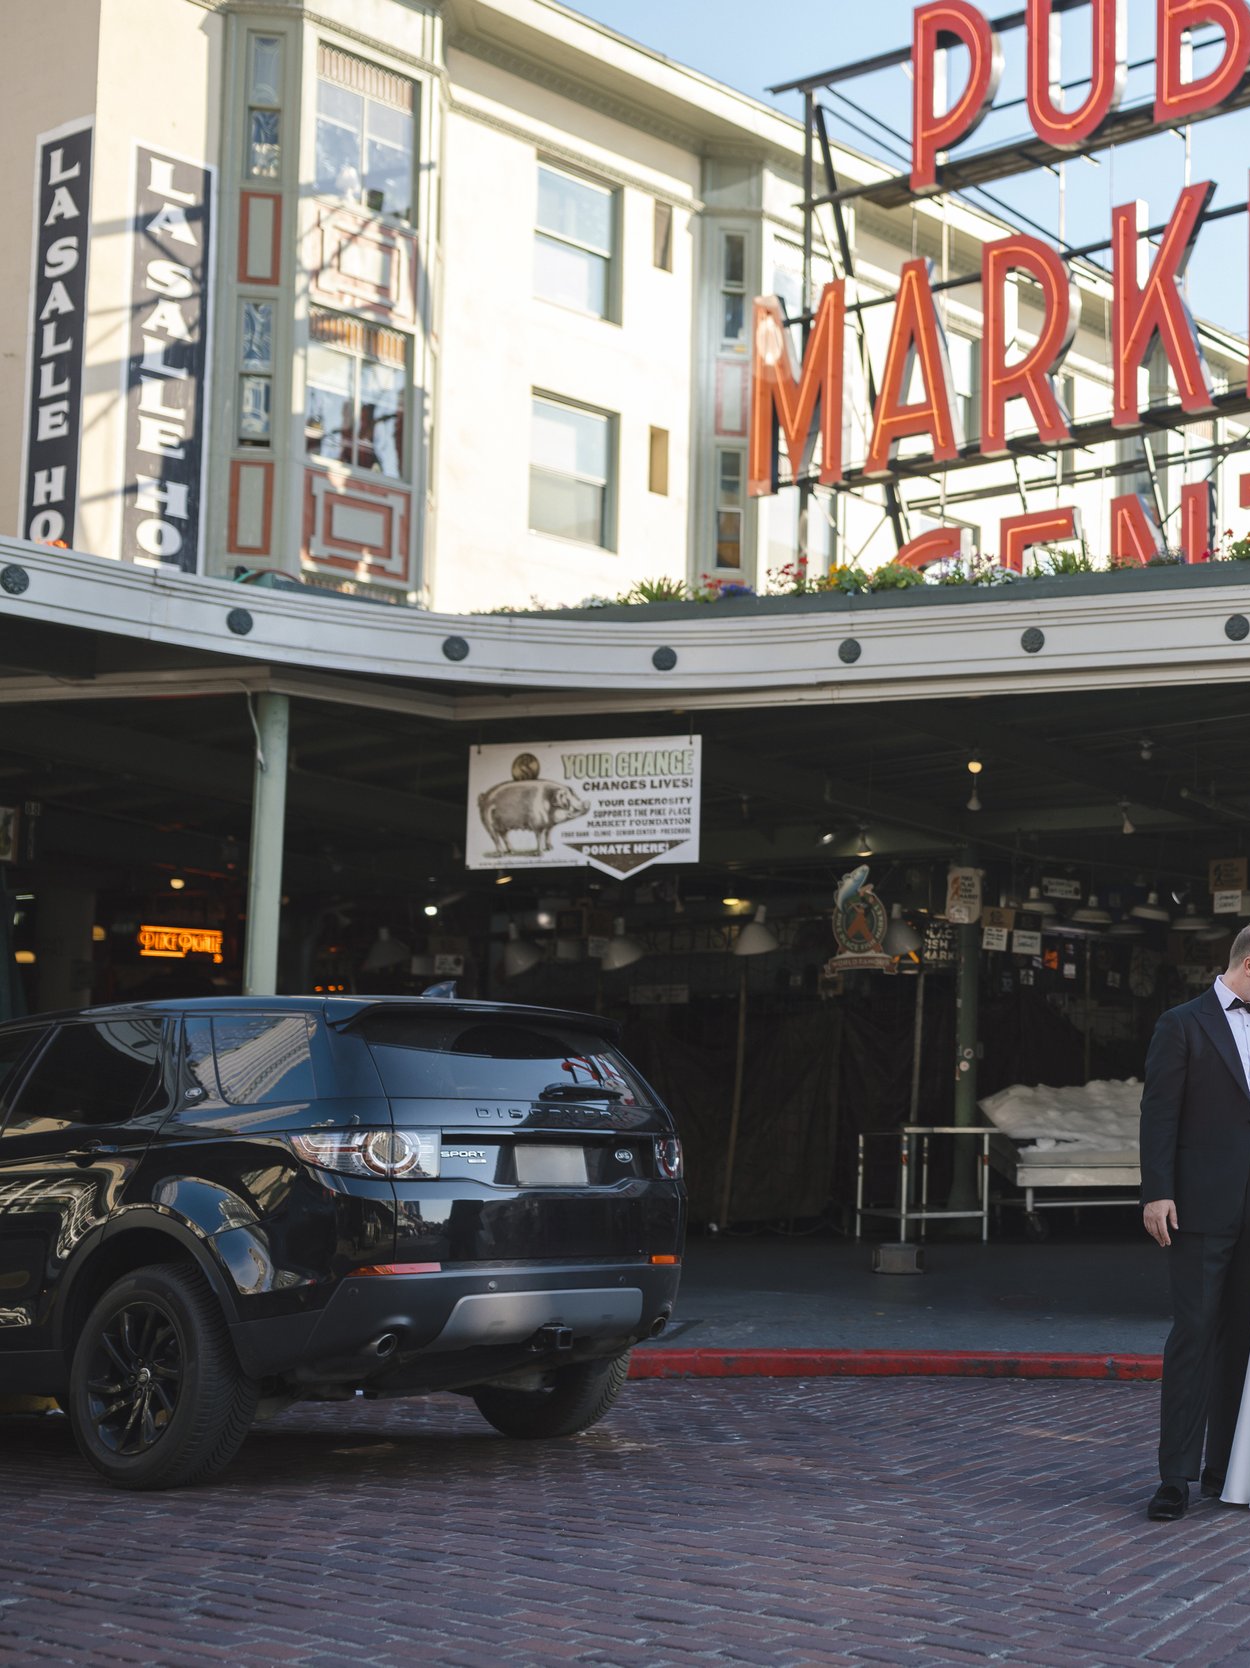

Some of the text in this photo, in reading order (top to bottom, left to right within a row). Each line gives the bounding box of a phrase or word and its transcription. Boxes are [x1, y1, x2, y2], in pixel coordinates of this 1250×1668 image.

[44, 146, 82, 227] LA
[145, 157, 198, 247] LA
[36, 237, 81, 443] SALLE
[133, 258, 195, 460] SALLE
[561, 749, 695, 780] YOUR CHANGE
[582, 778, 694, 793] CHANGES LIVES!
[598, 796, 693, 808] YOUR GENEROSITY
[593, 809, 632, 818] SUPPORTS
[634, 808, 648, 817] THE
[649, 808, 666, 817] PIKE
[587, 817, 692, 828] MARKET FOUNDATION
[582, 842, 669, 856] DONATE HERE!
[440, 1150, 486, 1158] SPORT
